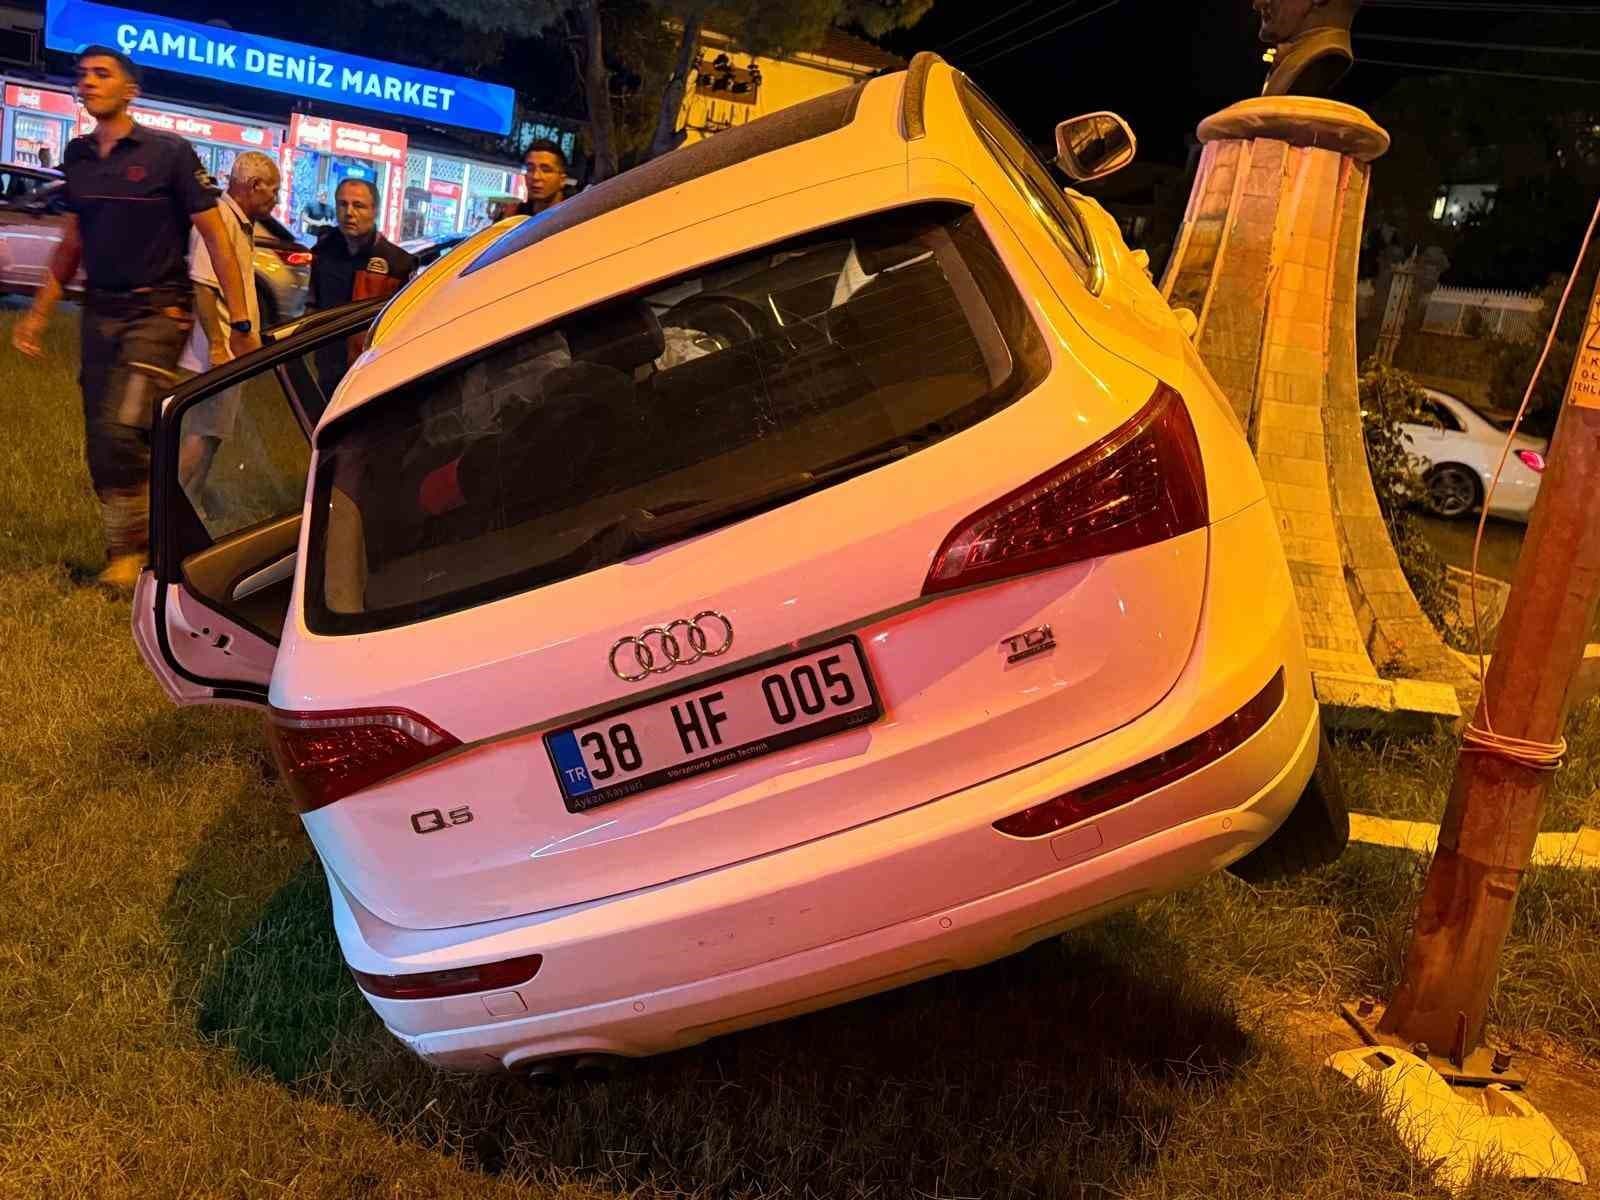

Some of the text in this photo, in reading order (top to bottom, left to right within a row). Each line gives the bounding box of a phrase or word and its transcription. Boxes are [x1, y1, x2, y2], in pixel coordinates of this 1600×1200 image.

[117, 24, 455, 112] ÇAMLIK DENİZ MARKET
[1574, 382, 1600, 396] TEHL
[579, 655, 855, 781] 38 HF 005
[565, 766, 588, 783] TR
[411, 805, 474, 834] Q5
